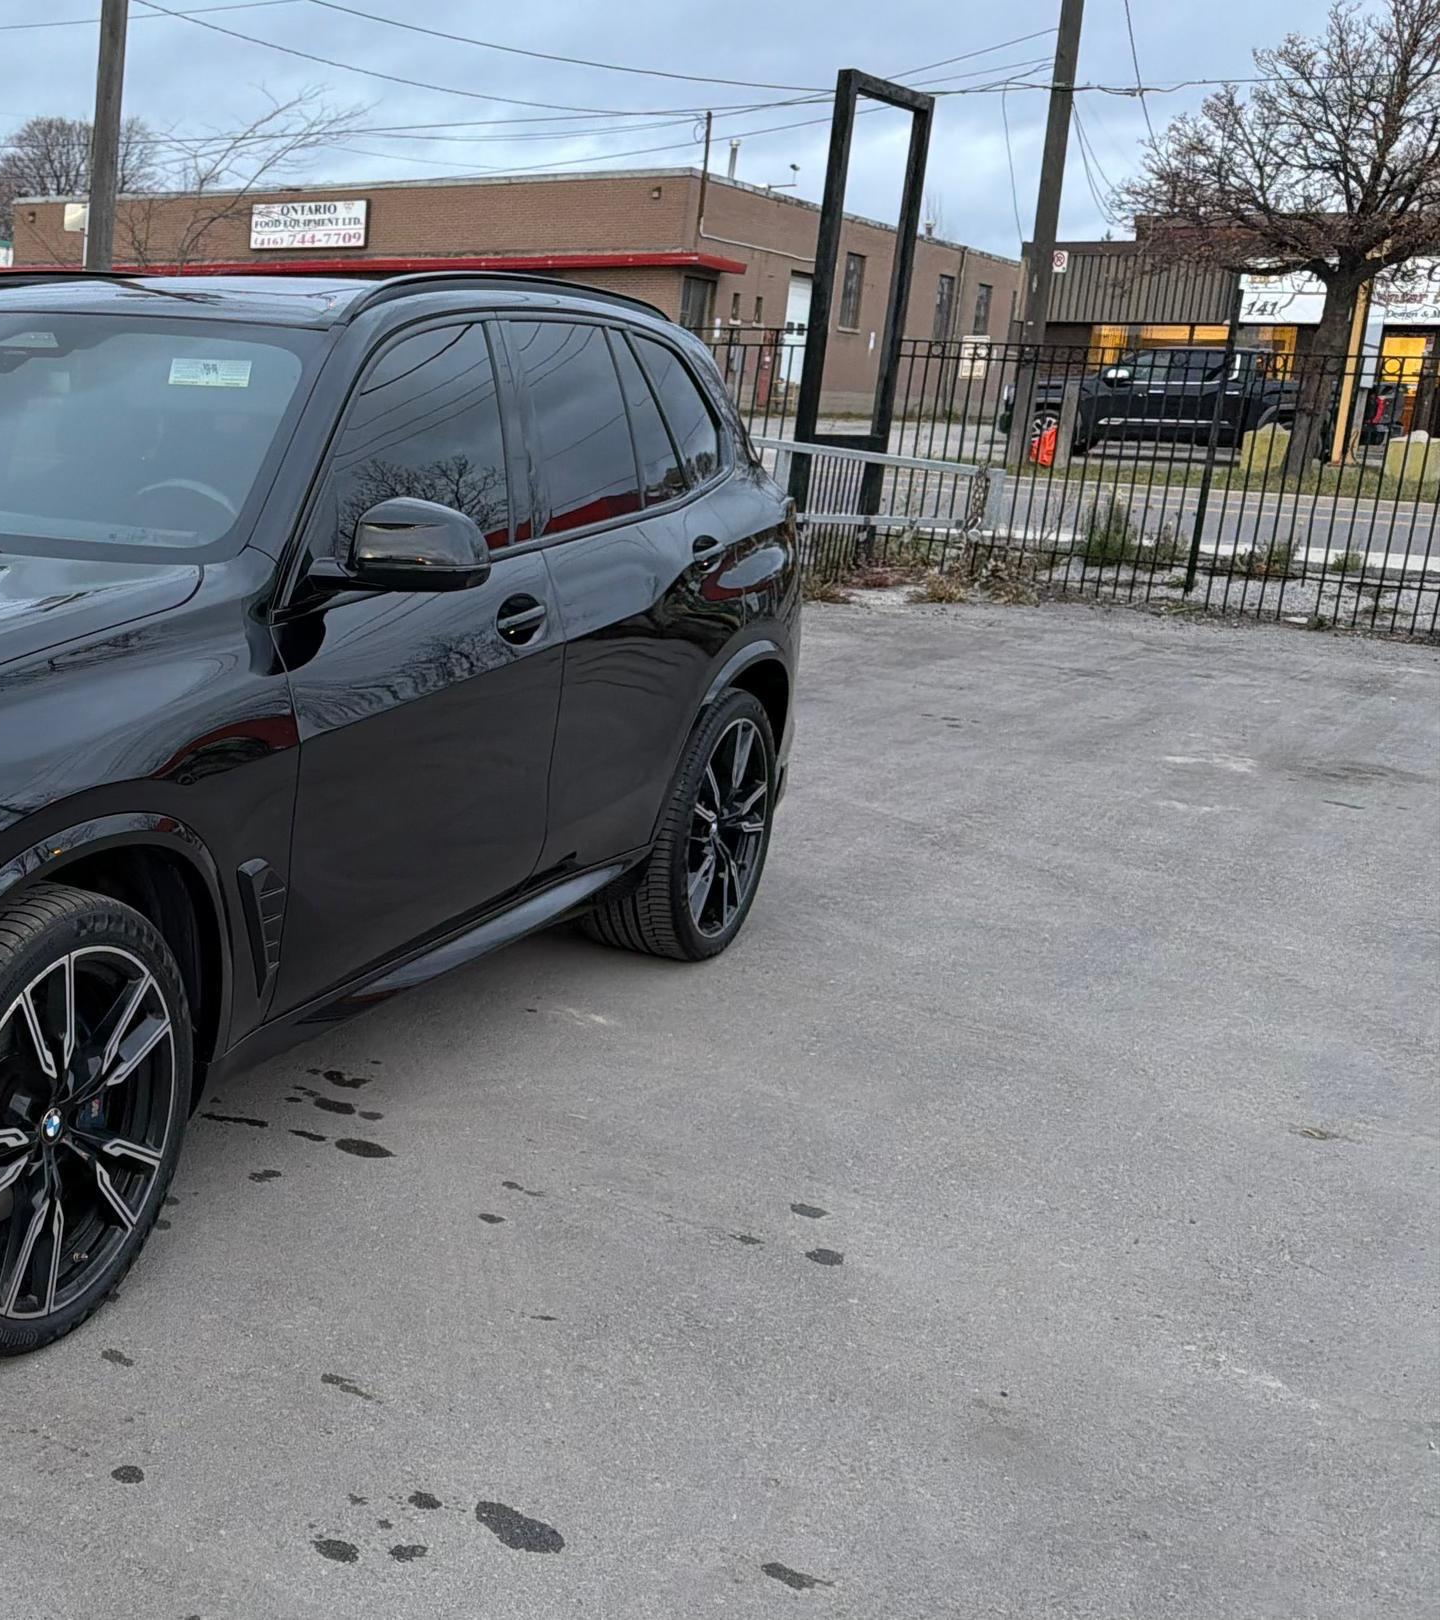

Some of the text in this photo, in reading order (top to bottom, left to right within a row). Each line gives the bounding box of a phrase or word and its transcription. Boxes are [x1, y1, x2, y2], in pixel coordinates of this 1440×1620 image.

[280, 203, 337, 217] ONTARIO
[254, 216, 363, 230] FOOD EQUIPMENT LTD.
[254, 231, 362, 247] (416) 744-7709
[1245, 300, 1278, 316] 141
